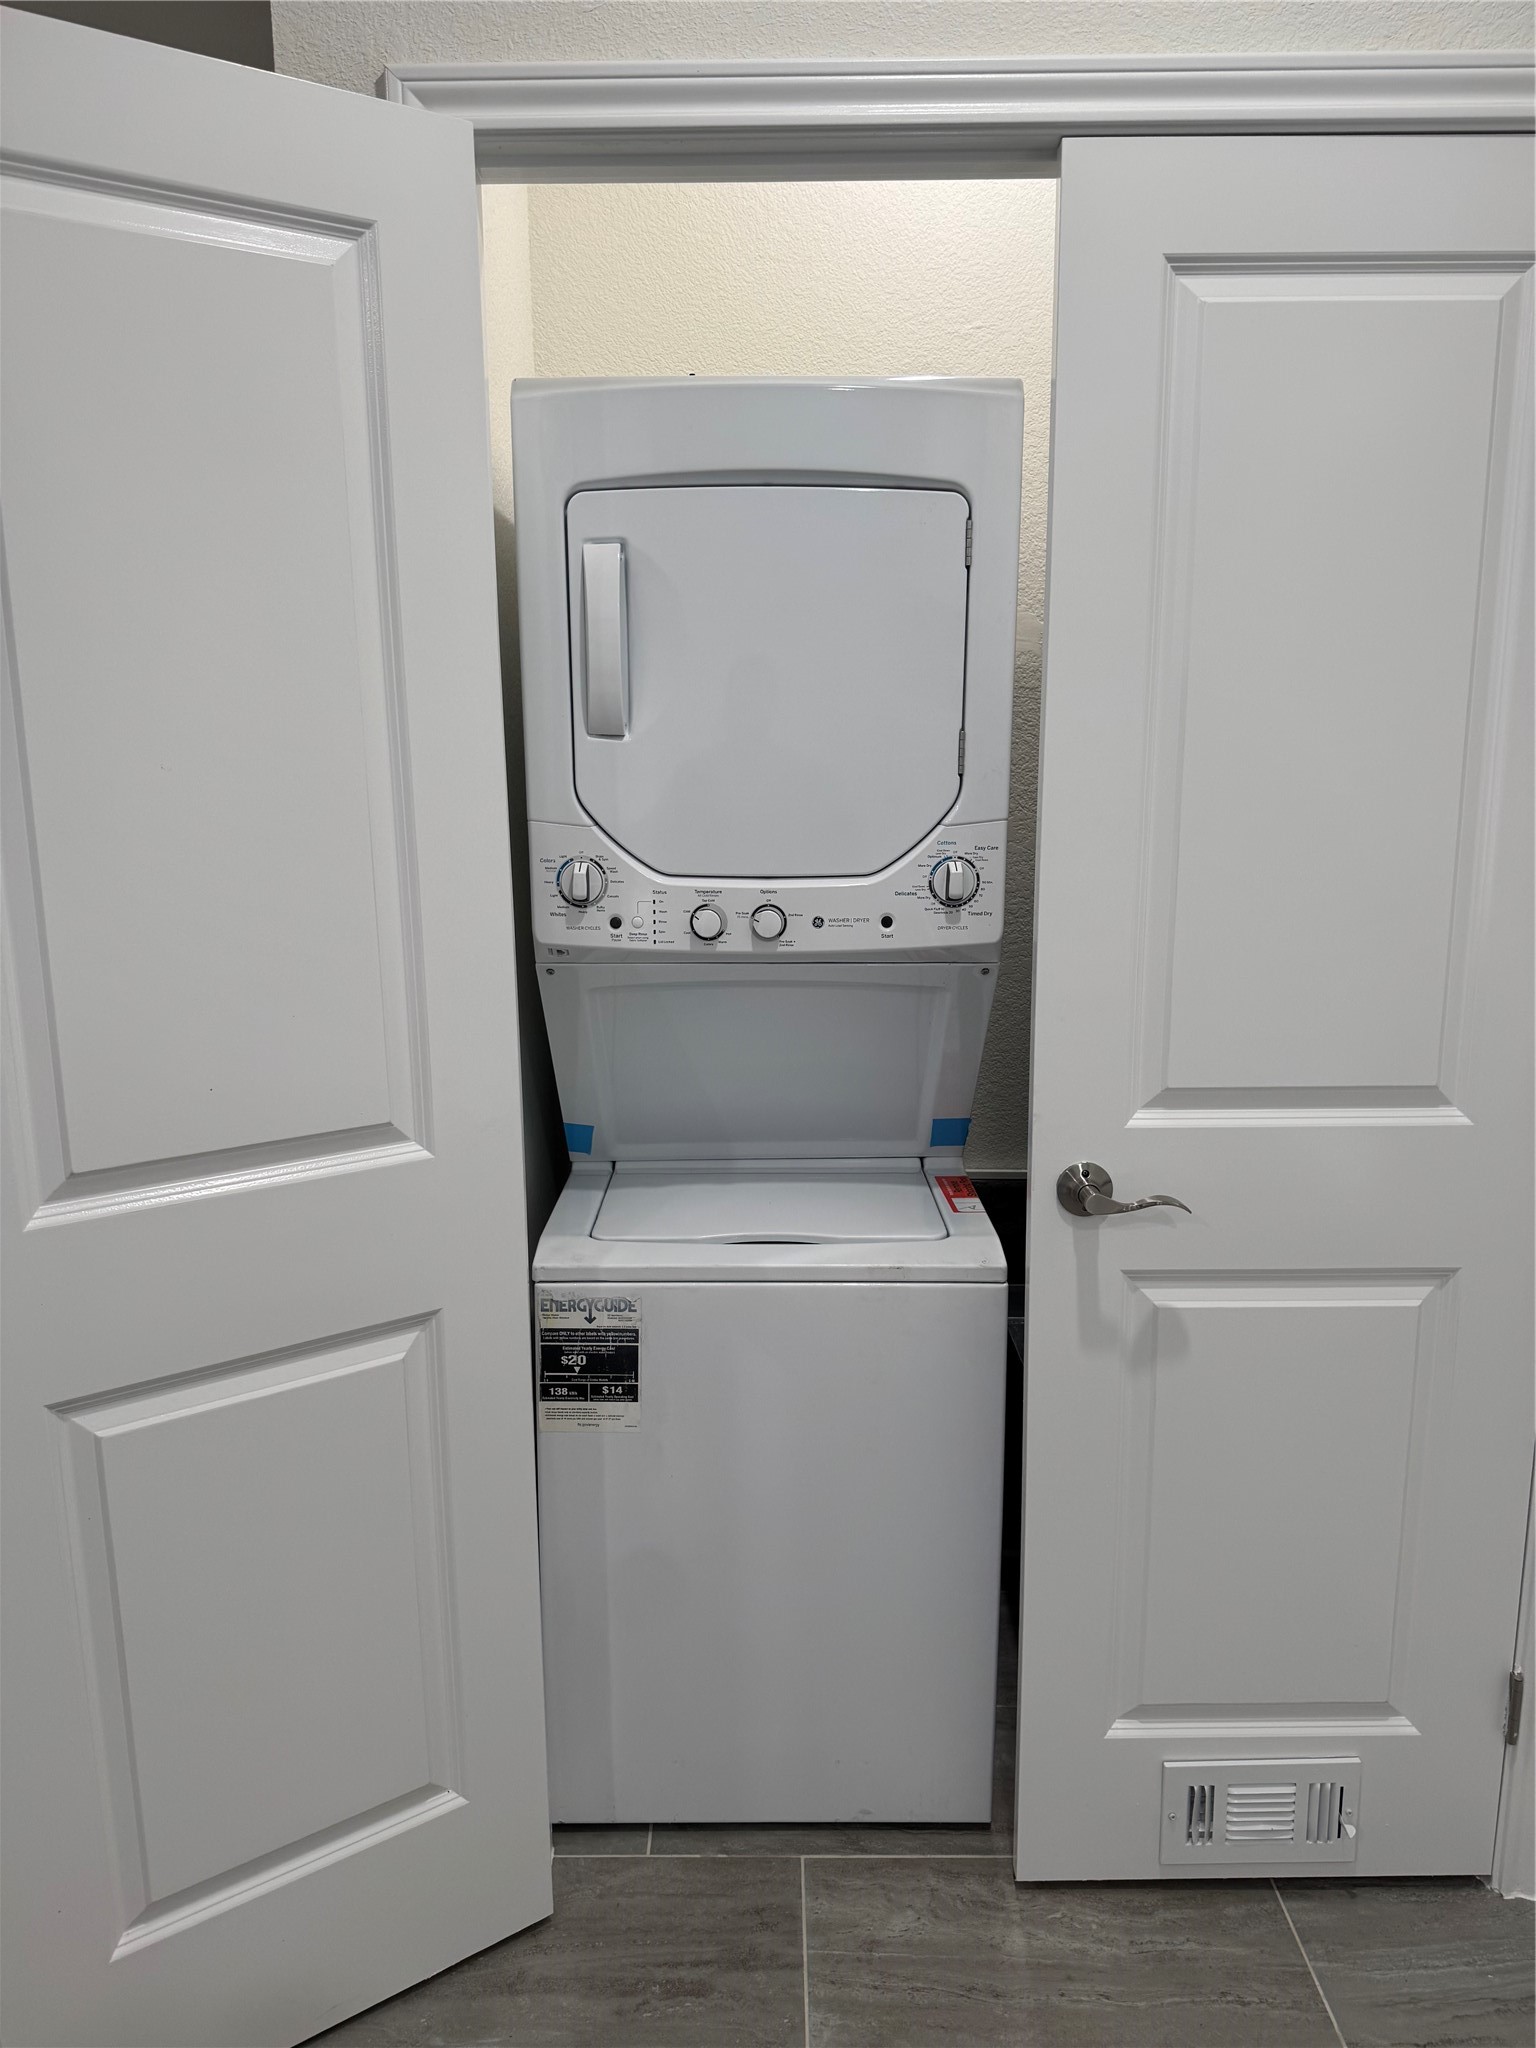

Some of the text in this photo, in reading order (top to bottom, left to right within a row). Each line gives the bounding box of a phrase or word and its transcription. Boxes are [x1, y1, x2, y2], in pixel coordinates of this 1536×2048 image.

[561, 1354, 587, 1366] $20
[548, 1387, 568, 1396] 138
[602, 1385, 623, 1395] $14
